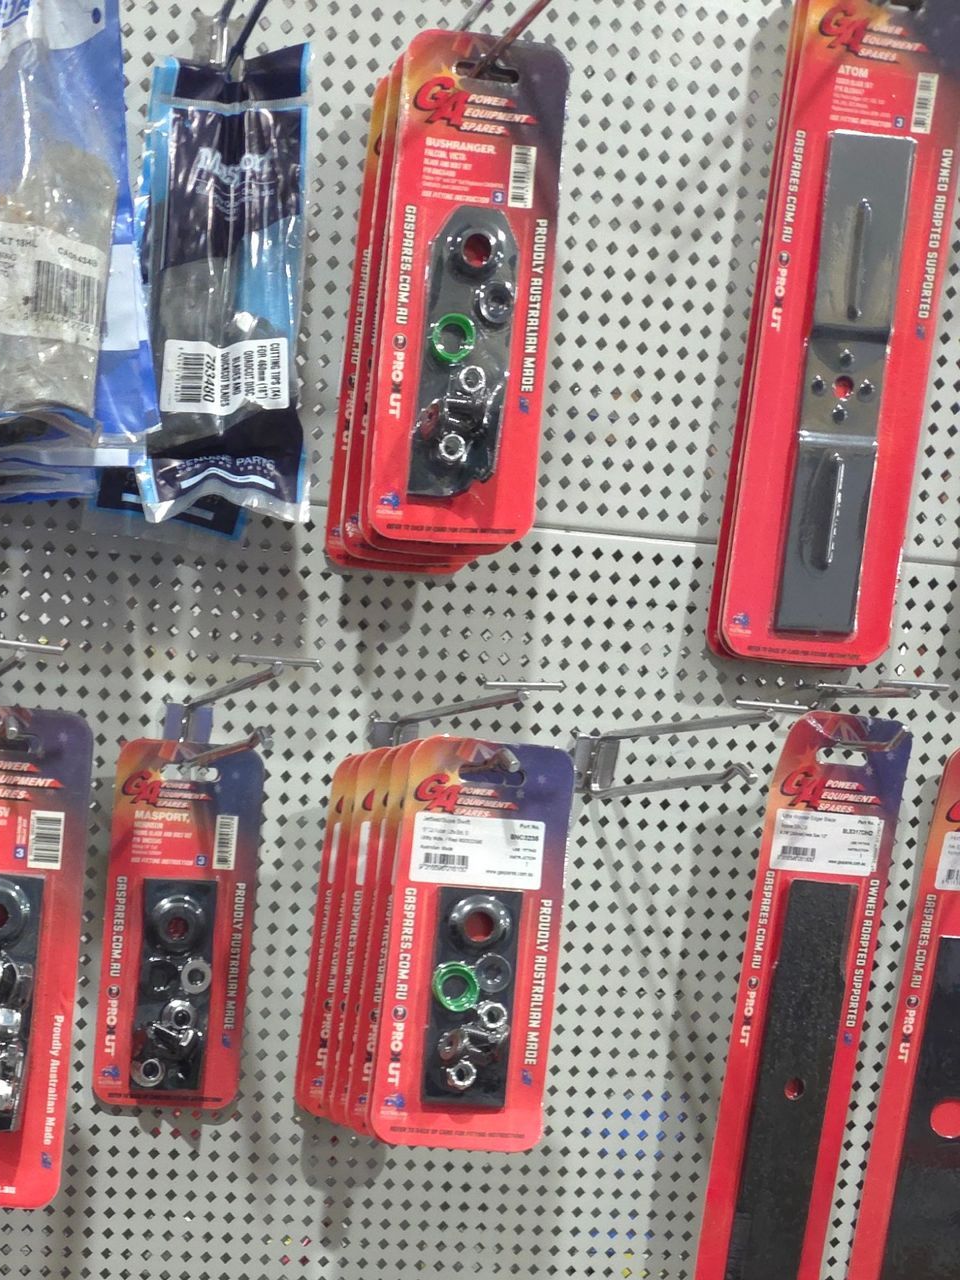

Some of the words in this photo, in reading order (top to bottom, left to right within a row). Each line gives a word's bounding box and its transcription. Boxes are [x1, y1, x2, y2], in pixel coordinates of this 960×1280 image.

[837, 64, 869, 78] ATOM
[413, 77, 470, 127] GA
[463, 108, 529, 123] EQUIPMENT
[467, 94, 508, 107] POWER
[896, 117, 904, 128] 3
[460, 121, 504, 135] SPARES
[782, 130, 807, 243] GASPARES.COM.AU
[937, 148, 954, 192] OWNED
[494, 192, 503, 203] 3
[929, 195, 947, 249] ADAPTED
[396, 205, 417, 325] GASPARES.COM.AU
[529, 219, 548, 275] PROUDLY
[918, 251, 938, 319] SUPPORTED
[524, 277, 544, 356] AUSTRALIAN
[520, 357, 536, 393] MADE
[16, 848, 25, 859] 3
[198, 856, 206, 866] 3
[232, 883, 247, 931] PROUDLY
[751, 870, 776, 970] GASPARES.COM.AU
[866, 878, 881, 918] OWNED
[110, 876, 128, 977] GASPARES.COM.AU
[394, 887, 417, 1000] GASPARES.COM.AU
[536, 899, 552, 952] PROUDLY
[857, 921, 874, 966] ADAPTED
[908, 894, 938, 990] GASPARES.COM.AU
[228, 932, 244, 1000] AUSTRALIAN
[528, 954, 548, 1029] AUSTRALIAN
[845, 967, 867, 1029] SUPPORTED
[50, 1014, 65, 1048] Proudly
[223, 1001, 237, 1031] MADE
[524, 1031, 538, 1065] MADE
[44, 1050, 61, 1115] Australian
[42, 1117, 57, 1146] Made
